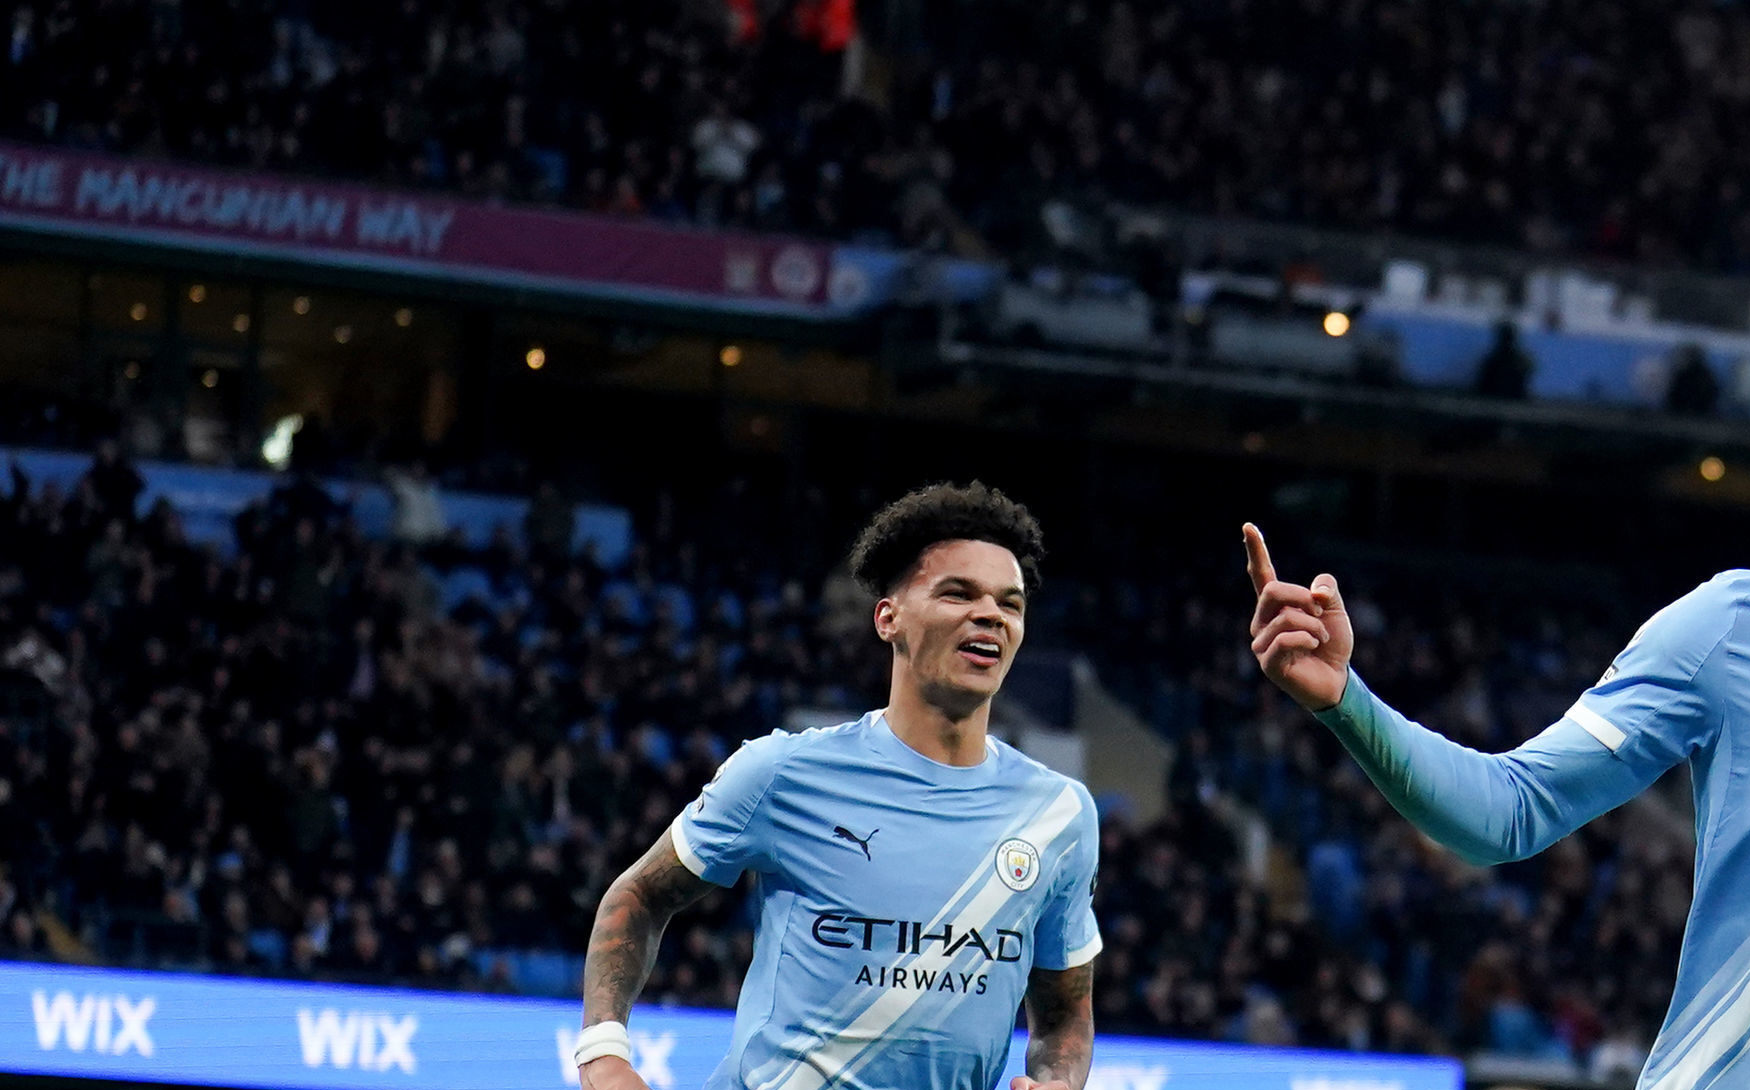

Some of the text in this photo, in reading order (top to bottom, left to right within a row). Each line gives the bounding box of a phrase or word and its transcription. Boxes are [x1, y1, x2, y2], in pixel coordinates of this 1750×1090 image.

[0, 154, 62, 206] HE
[811, 914, 1023, 962] ETIHAD
[855, 965, 988, 995] AIRWAYS
[32, 990, 155, 1057] WIX
[298, 1009, 417, 1073] WIX
